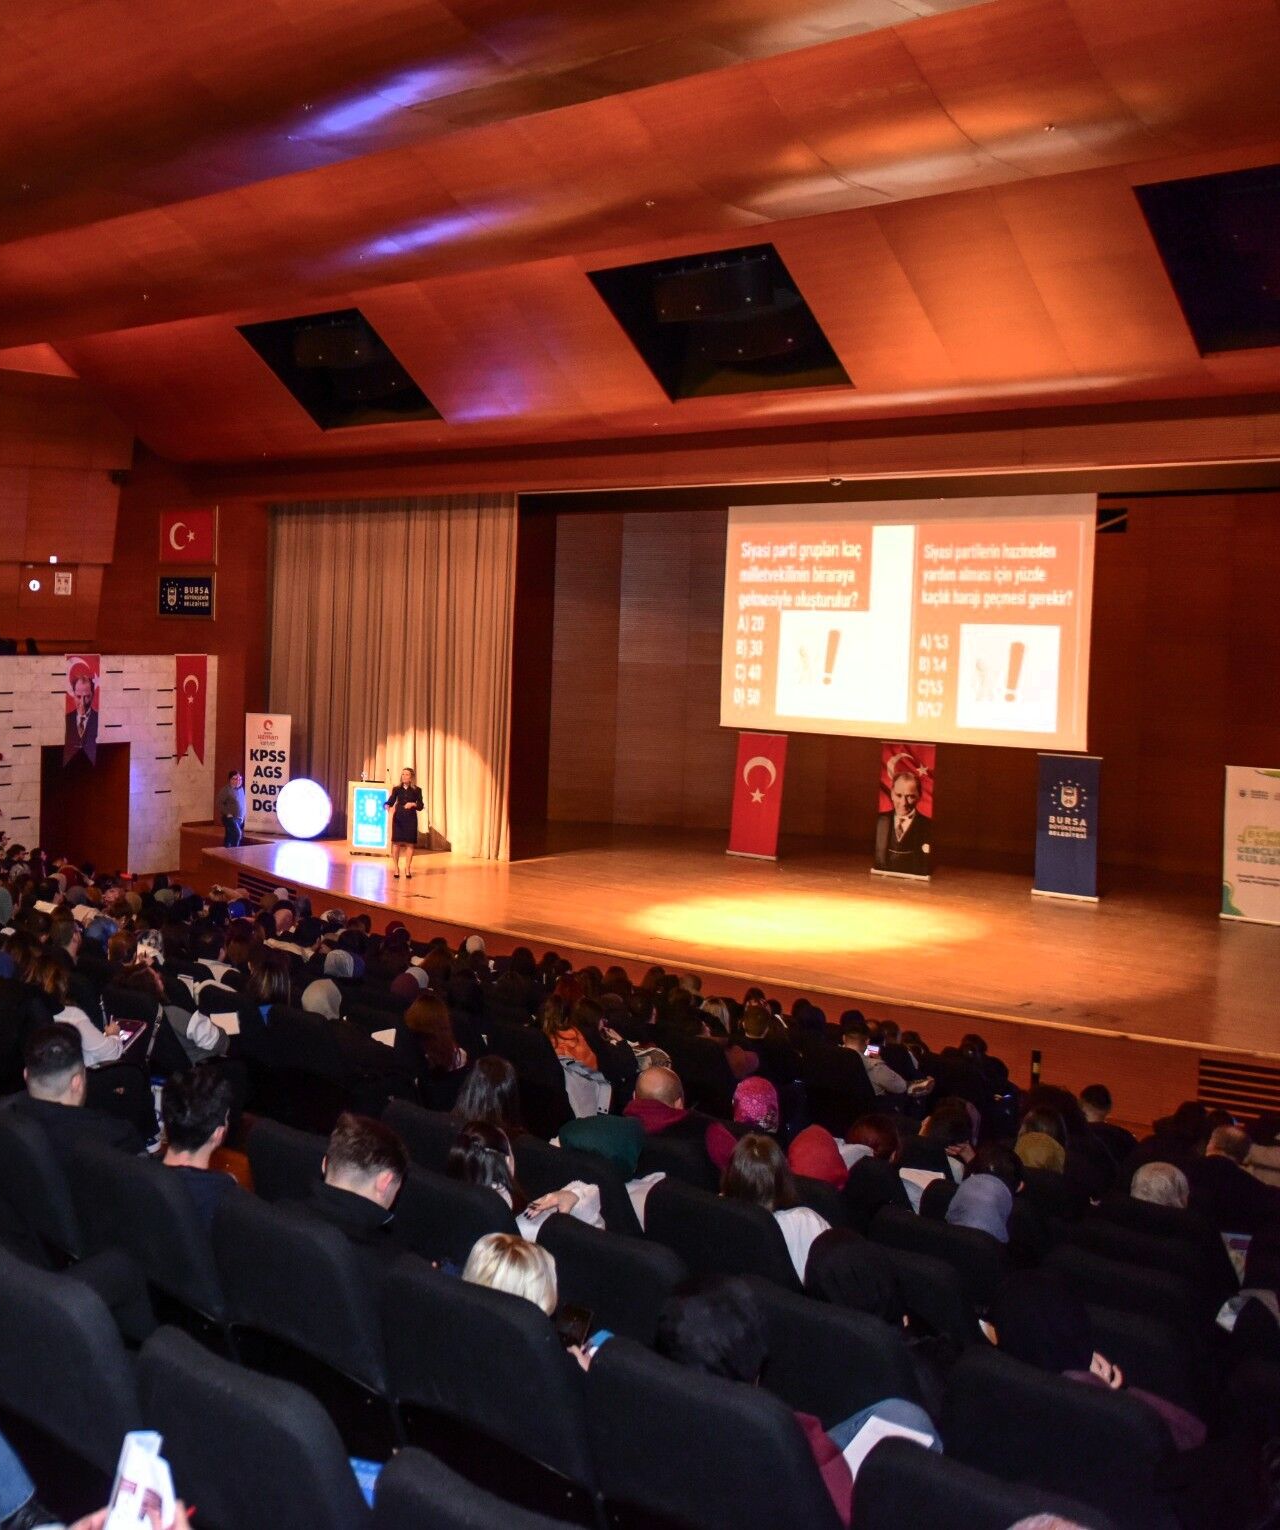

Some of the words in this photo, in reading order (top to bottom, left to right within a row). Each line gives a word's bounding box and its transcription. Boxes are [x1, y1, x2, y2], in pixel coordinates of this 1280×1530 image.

[772, 541, 797, 561] parti
[841, 539, 862, 560] kaç
[184, 586, 209, 594] BURSA
[736, 615, 750, 633] A)
[751, 615, 765, 632] 20
[250, 749, 286, 763] KPSS
[253, 765, 283, 779] AGS
[250, 780, 284, 795] ÖABT
[1048, 815, 1087, 827] BURSA
